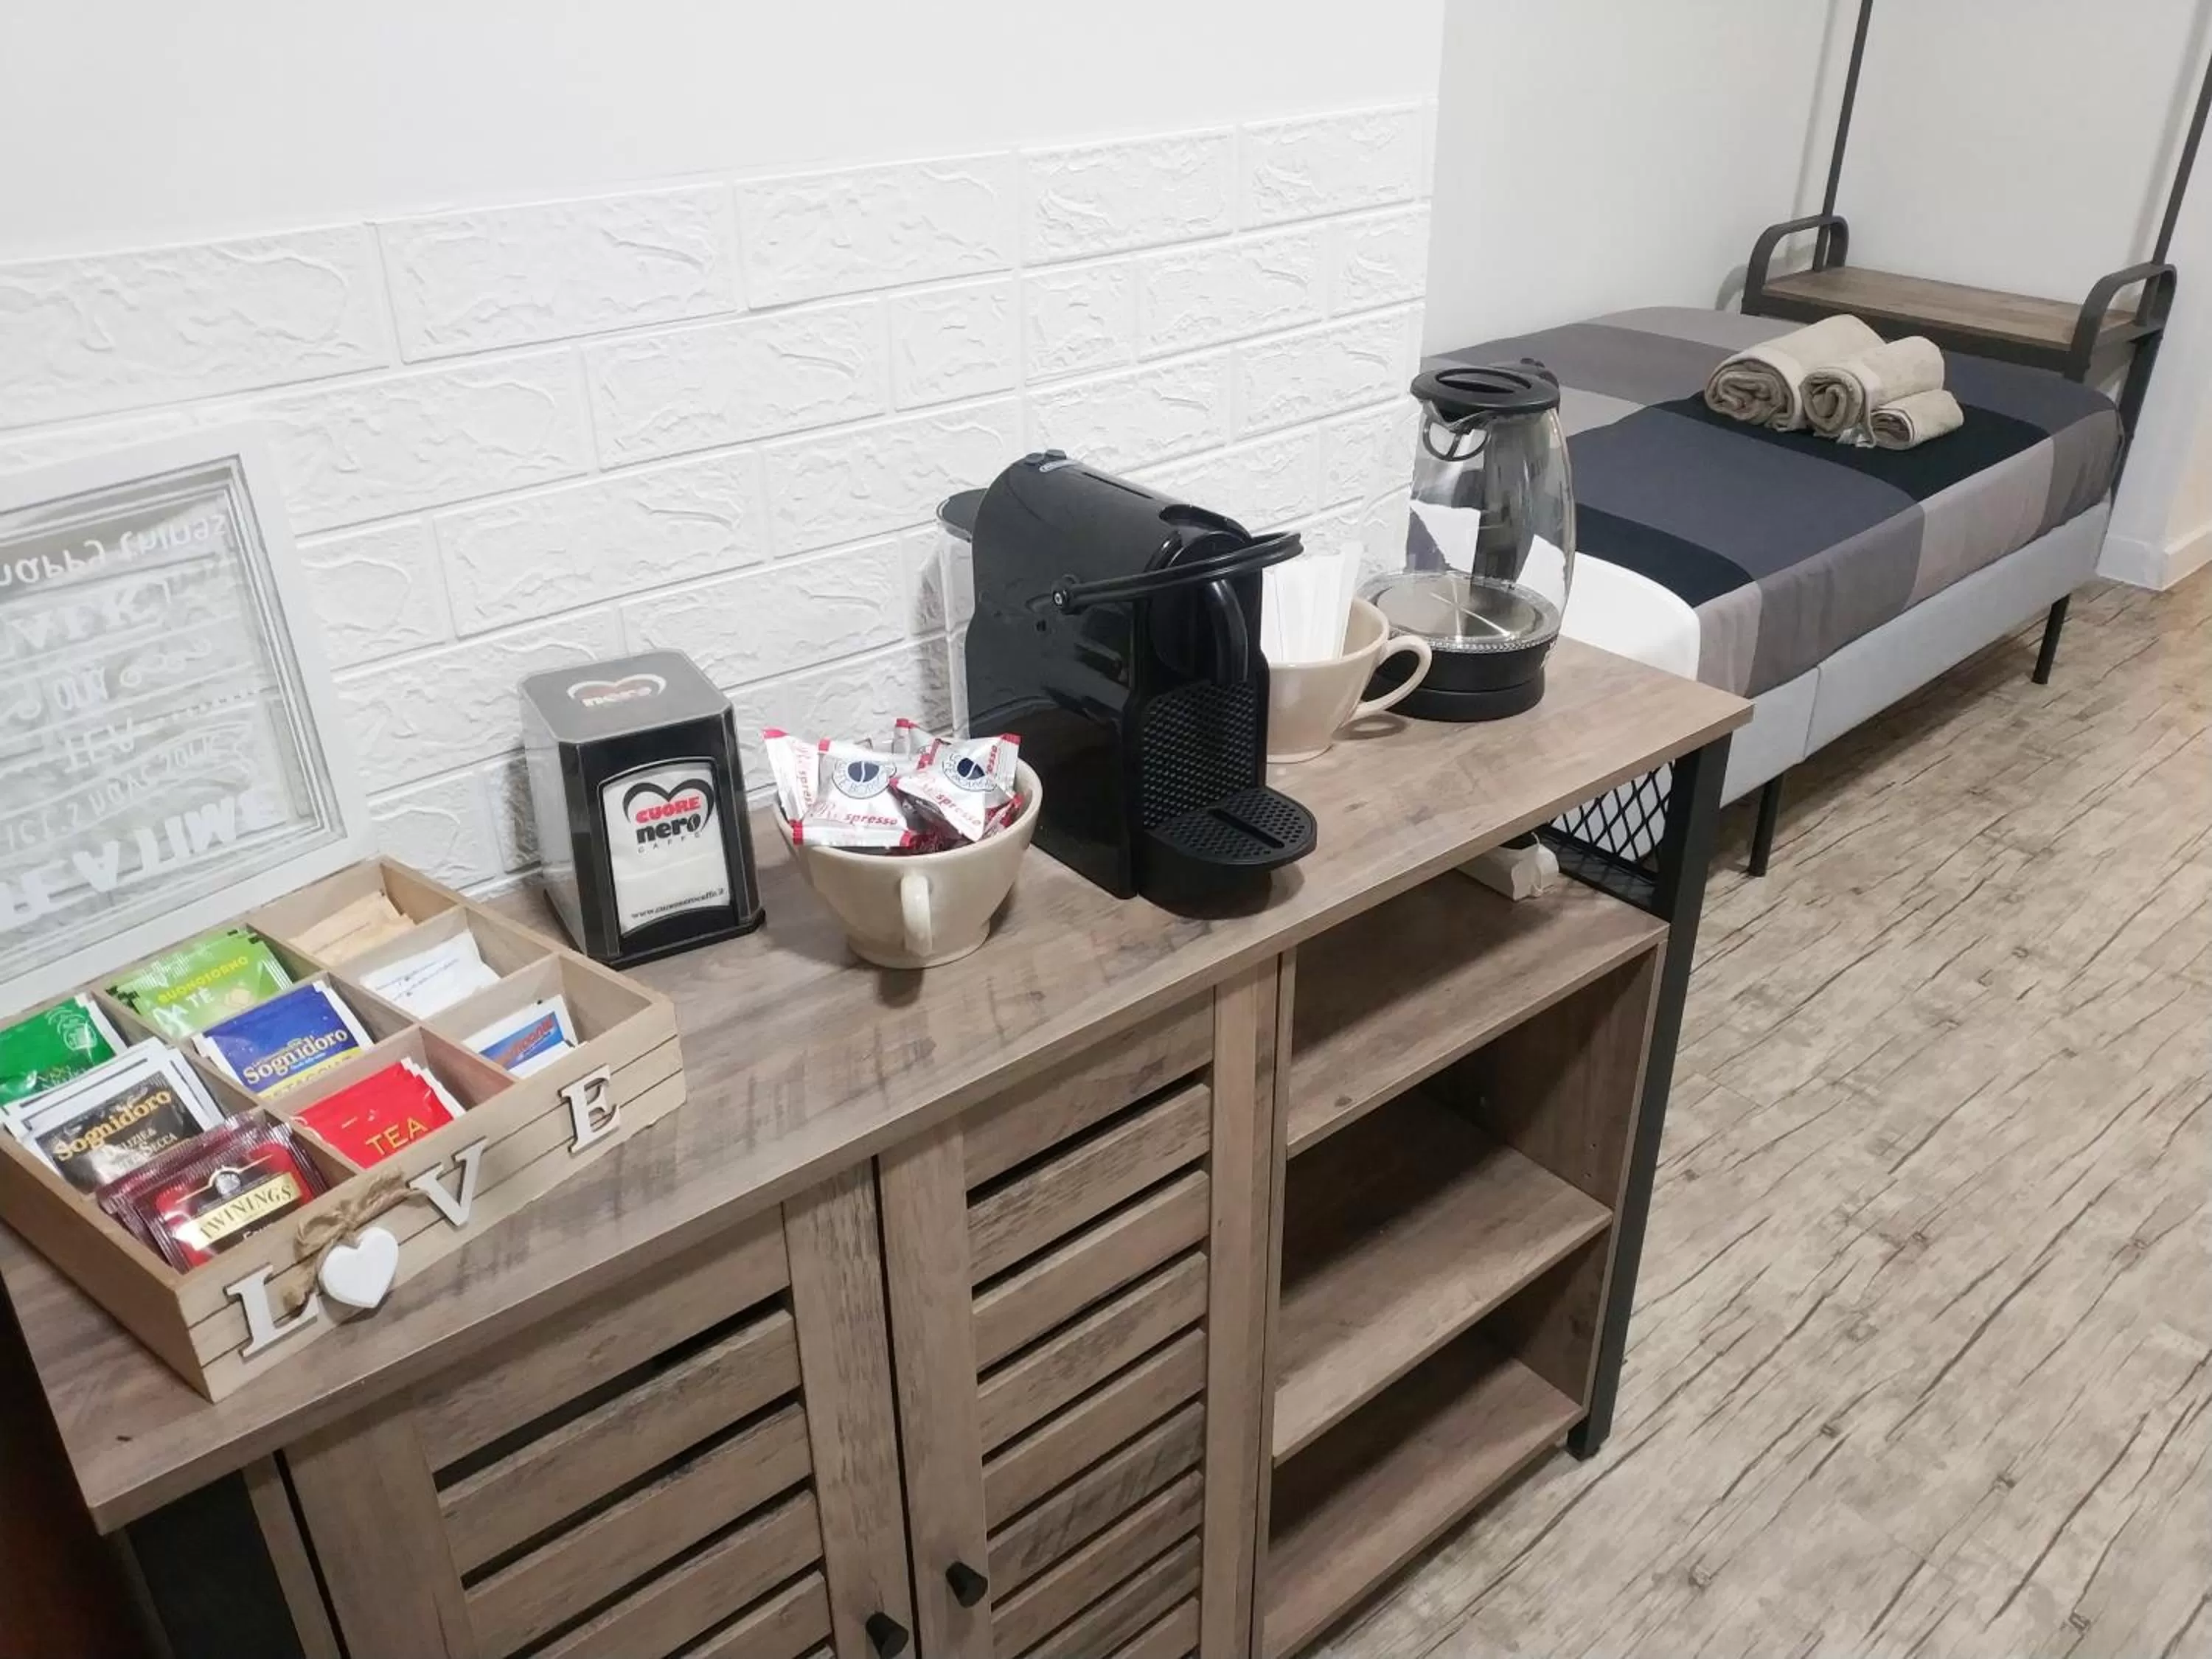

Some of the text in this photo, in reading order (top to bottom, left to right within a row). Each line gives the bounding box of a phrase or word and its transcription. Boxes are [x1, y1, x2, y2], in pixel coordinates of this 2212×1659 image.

[636, 796, 700, 824] CUORE
[636, 813, 701, 844] nero
[365, 1116, 428, 1155] TEA
[199, 1184, 293, 1239] TWININGS
